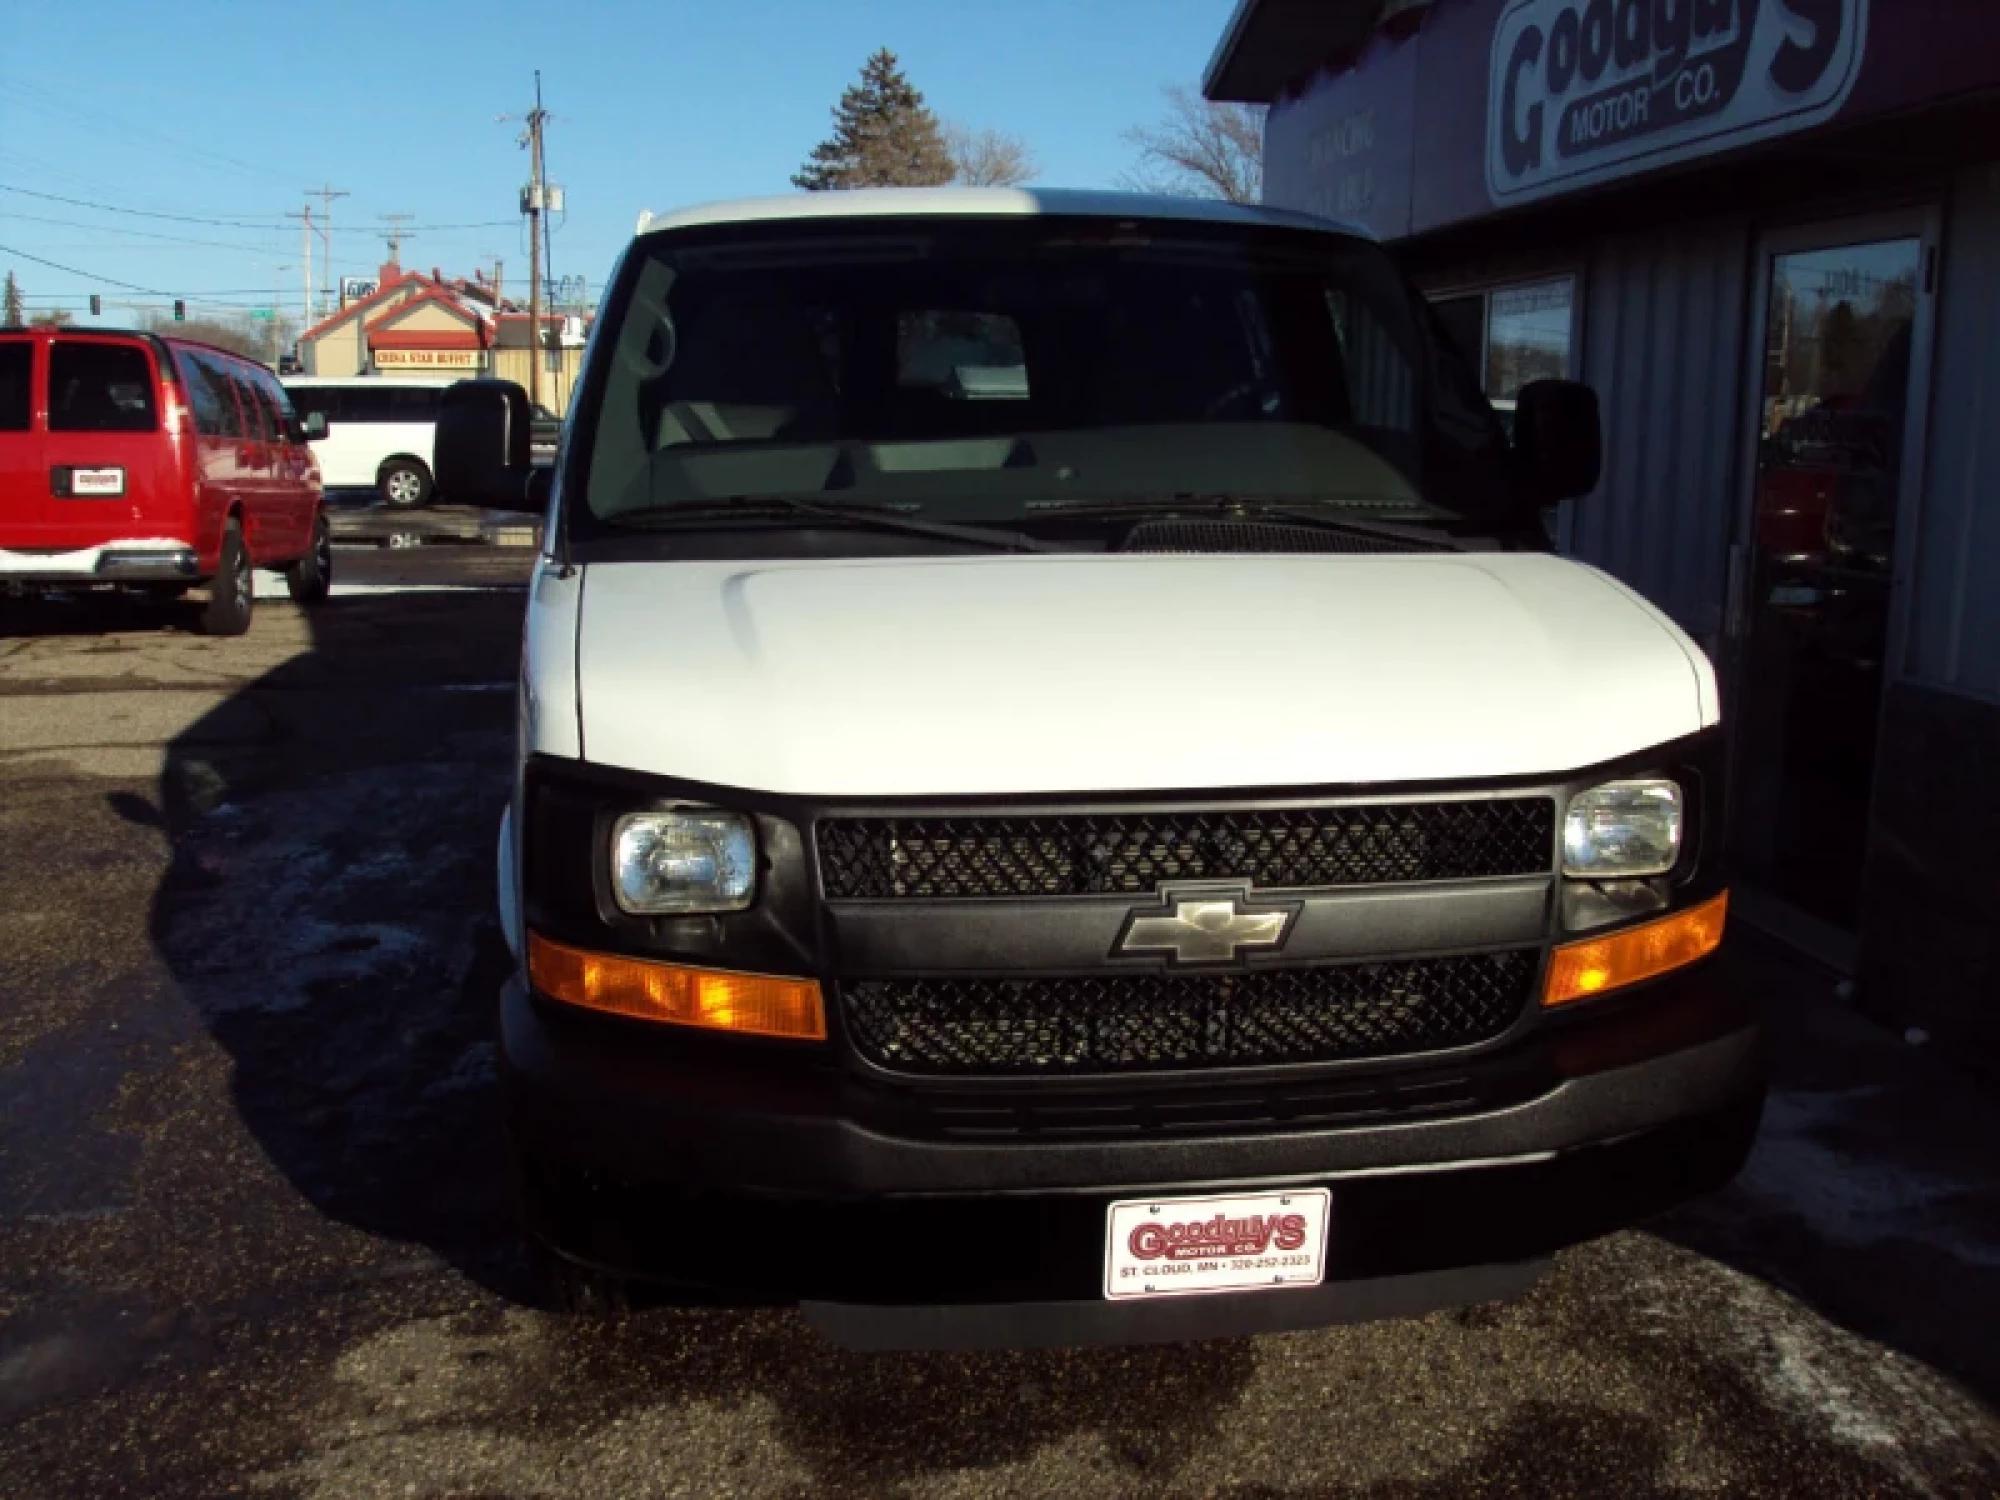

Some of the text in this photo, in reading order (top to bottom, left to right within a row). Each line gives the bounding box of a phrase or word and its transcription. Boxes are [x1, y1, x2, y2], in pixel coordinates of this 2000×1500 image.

[1570, 64, 1721, 144] MOTOR CO.
[1174, 1244, 1226, 1257] MOTOR
[1197, 1261, 1219, 1271] MN
